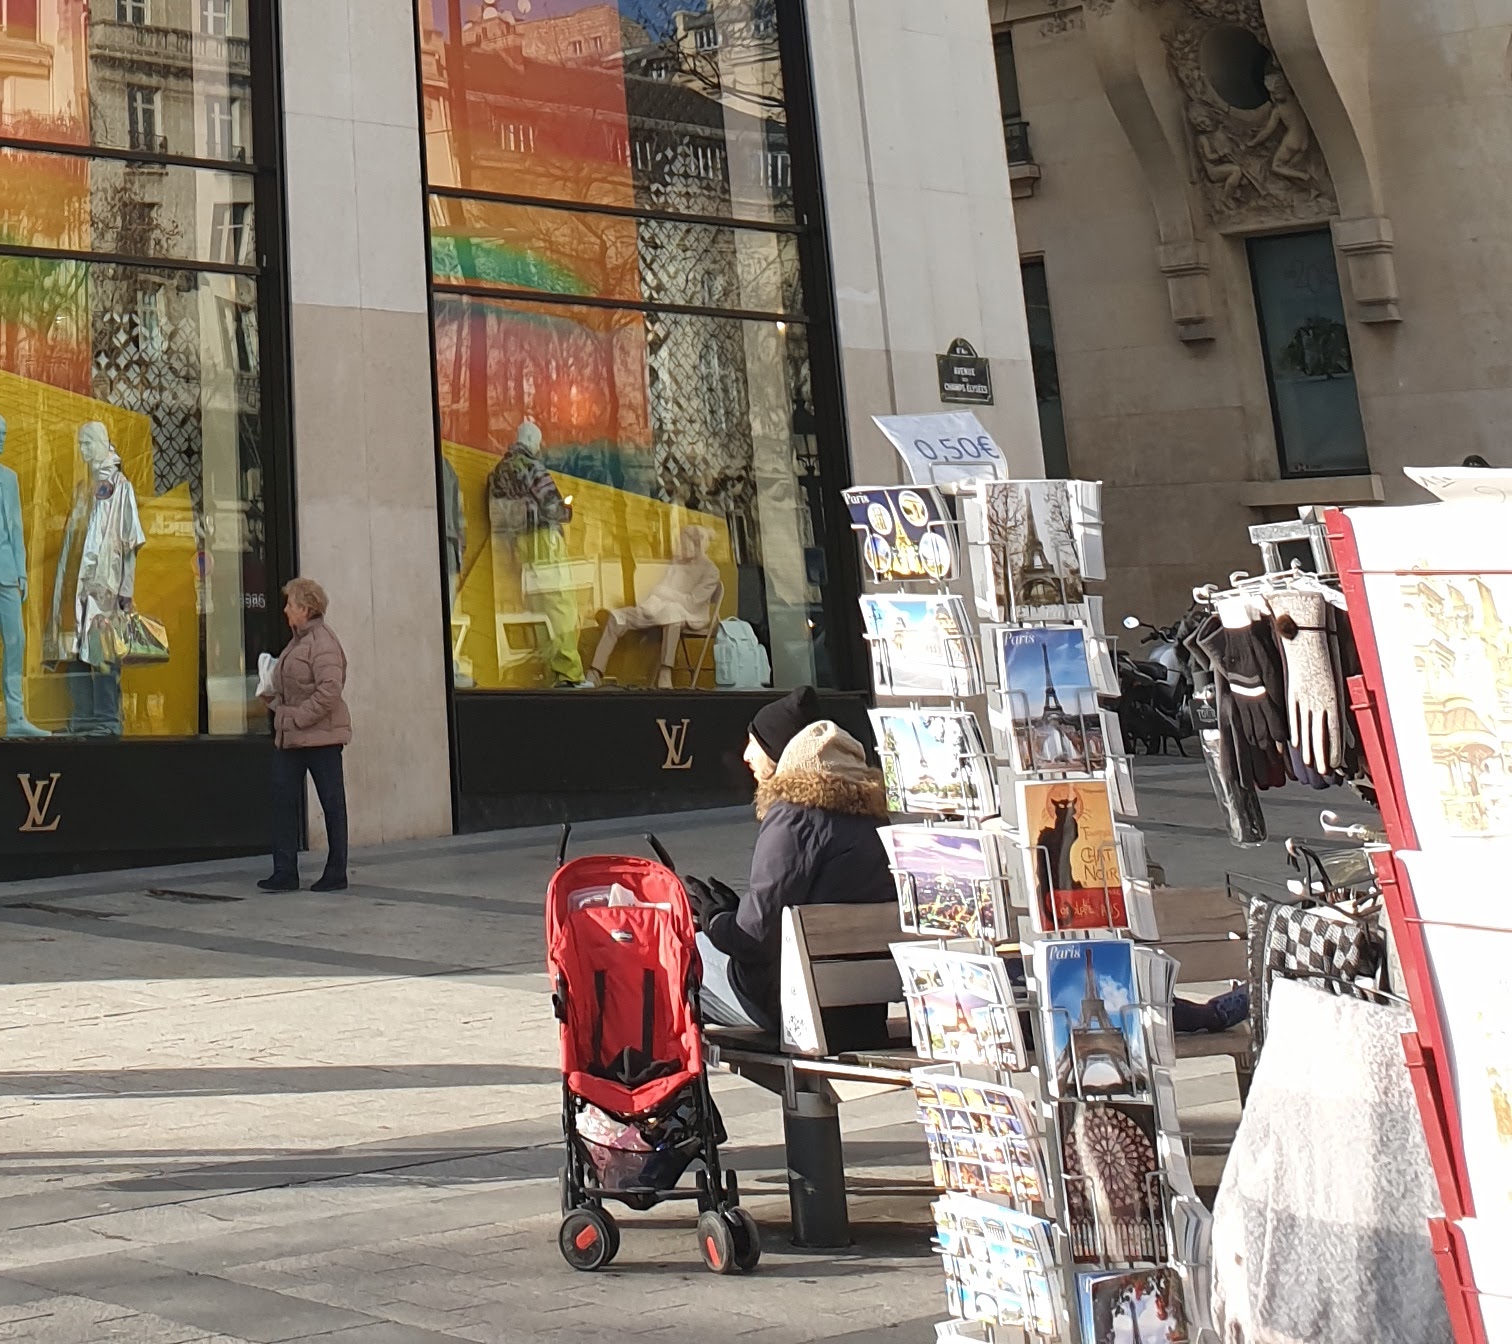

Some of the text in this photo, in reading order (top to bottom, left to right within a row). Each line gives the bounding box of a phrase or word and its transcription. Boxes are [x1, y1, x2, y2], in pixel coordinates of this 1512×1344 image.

[914, 436, 1000, 462] 0,50€
[844, 492, 871, 506] Paris
[1004, 631, 1036, 647] Paris
[1084, 864, 1121, 884] NOIR
[1049, 945, 1082, 961] Paris
